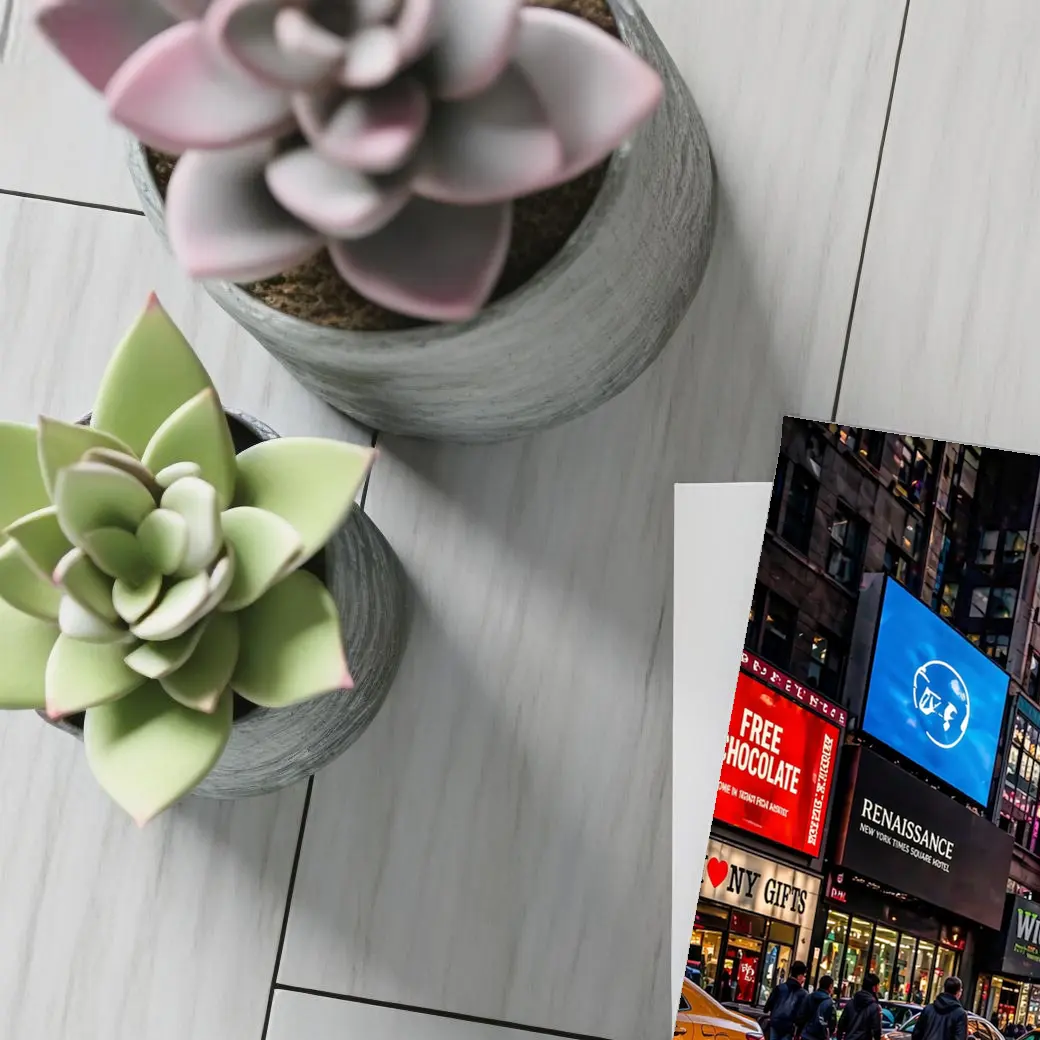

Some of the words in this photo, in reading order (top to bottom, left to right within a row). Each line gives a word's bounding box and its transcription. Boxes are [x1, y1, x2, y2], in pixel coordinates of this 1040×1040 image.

[740, 707, 783, 755] FREE
[723, 734, 801, 795] HOCOLATE
[859, 822, 876, 837] NEW
[875, 830, 892, 846] YORK
[891, 838, 910, 854] TIMES
[910, 847, 933, 864] SQUARE
[861, 798, 954, 860] RENAISSANCE
[726, 864, 761, 898] NY
[764, 878, 807, 914] GIFTS
